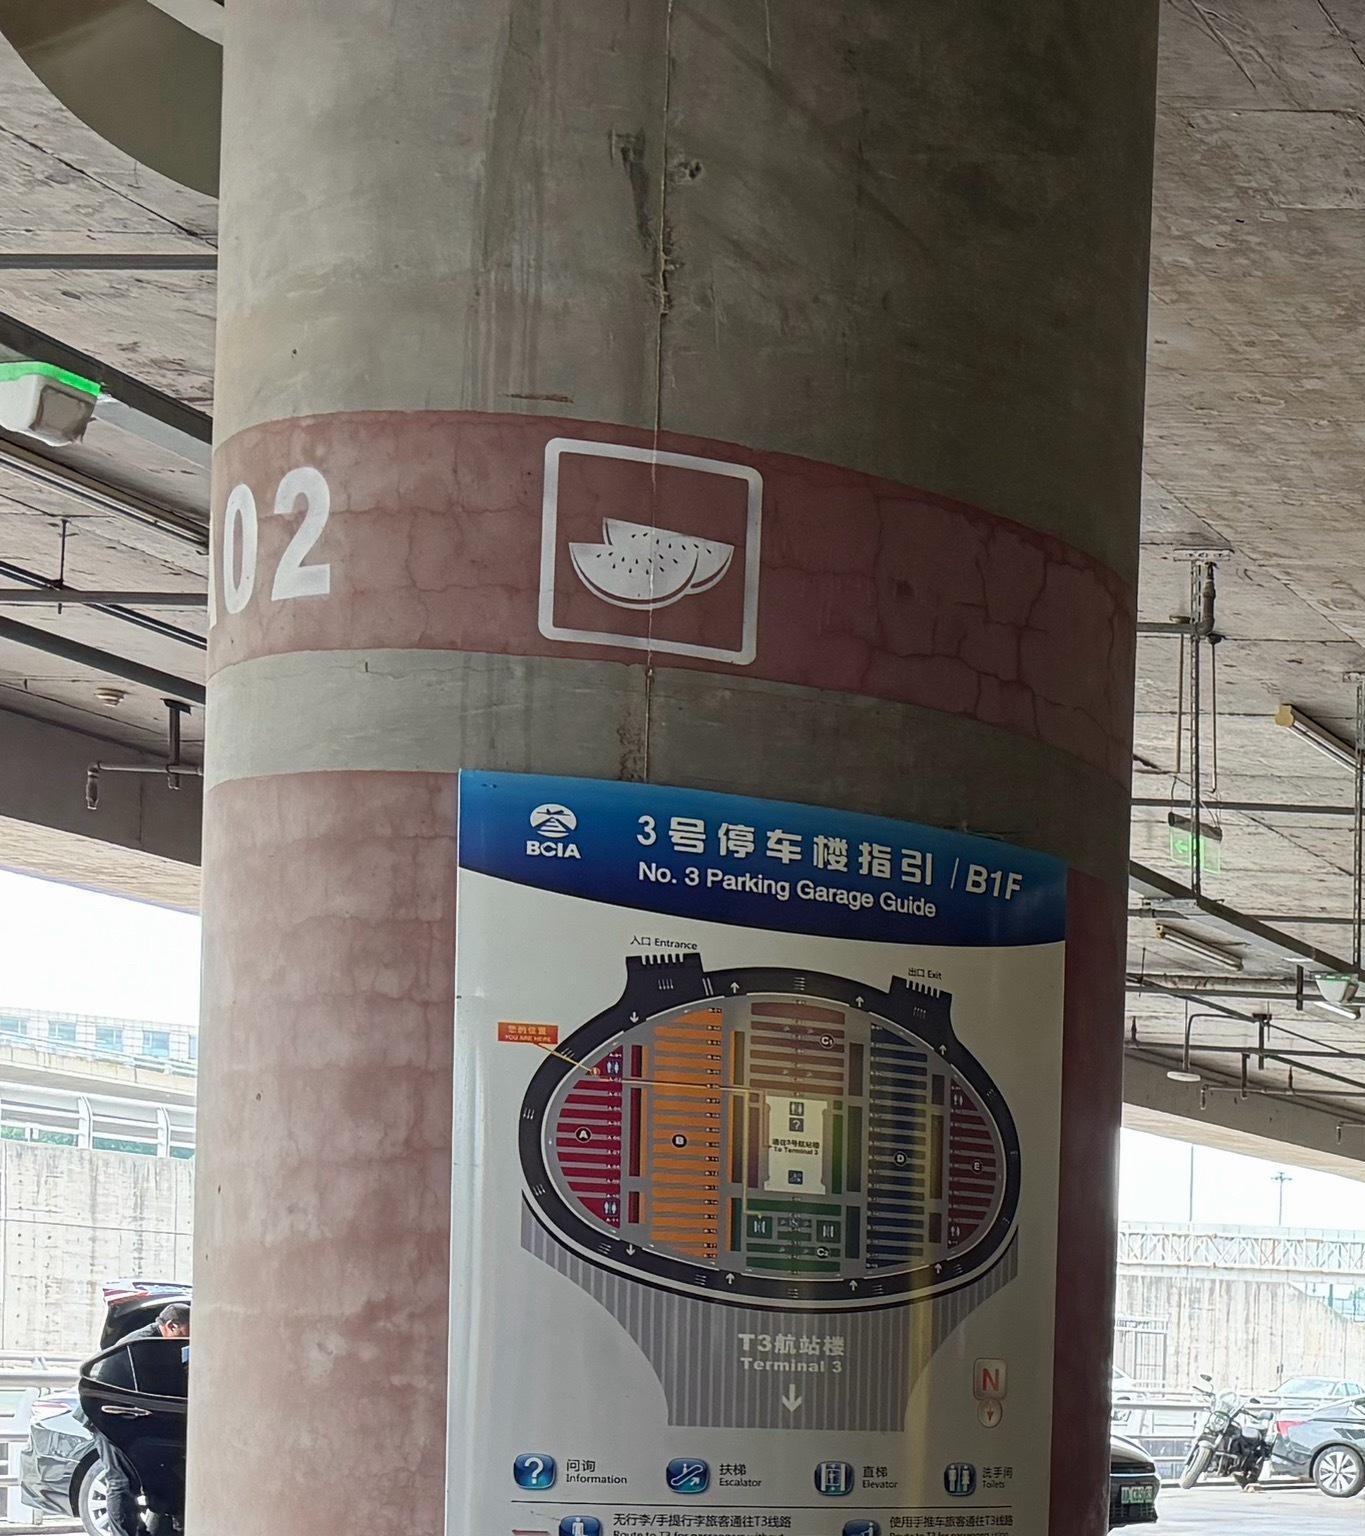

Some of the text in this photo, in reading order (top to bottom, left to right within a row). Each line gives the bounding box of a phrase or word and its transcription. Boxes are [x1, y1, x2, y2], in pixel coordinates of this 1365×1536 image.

[209, 467, 330, 614] 02
[526, 840, 582, 859] BCIA
[636, 815, 933, 886] 3号停车楼指引
[965, 863, 1023, 900] B1F
[638, 861, 936, 917] No. 3 Parking Garage Guide
[630, 936, 698, 950] 入口 Entrance
[908, 967, 925, 977] 出口
[578, 1130, 589, 1140] A
[675, 1136, 685, 1146] B
[738, 1333, 845, 1356] T3航站楼
[740, 1357, 843, 1373] Terminal 3
[982, 1368, 1000, 1391] N
[566, 1459, 596, 1472] 问询
[719, 1463, 747, 1476] 扶梯
[862, 1466, 888, 1478] 直梯
[566, 1474, 627, 1485] Information
[719, 1477, 762, 1488] Escalator
[862, 1480, 898, 1489] Elevator
[612, 1513, 792, 1529] 无行李/手提行李旅客通往T3线路
